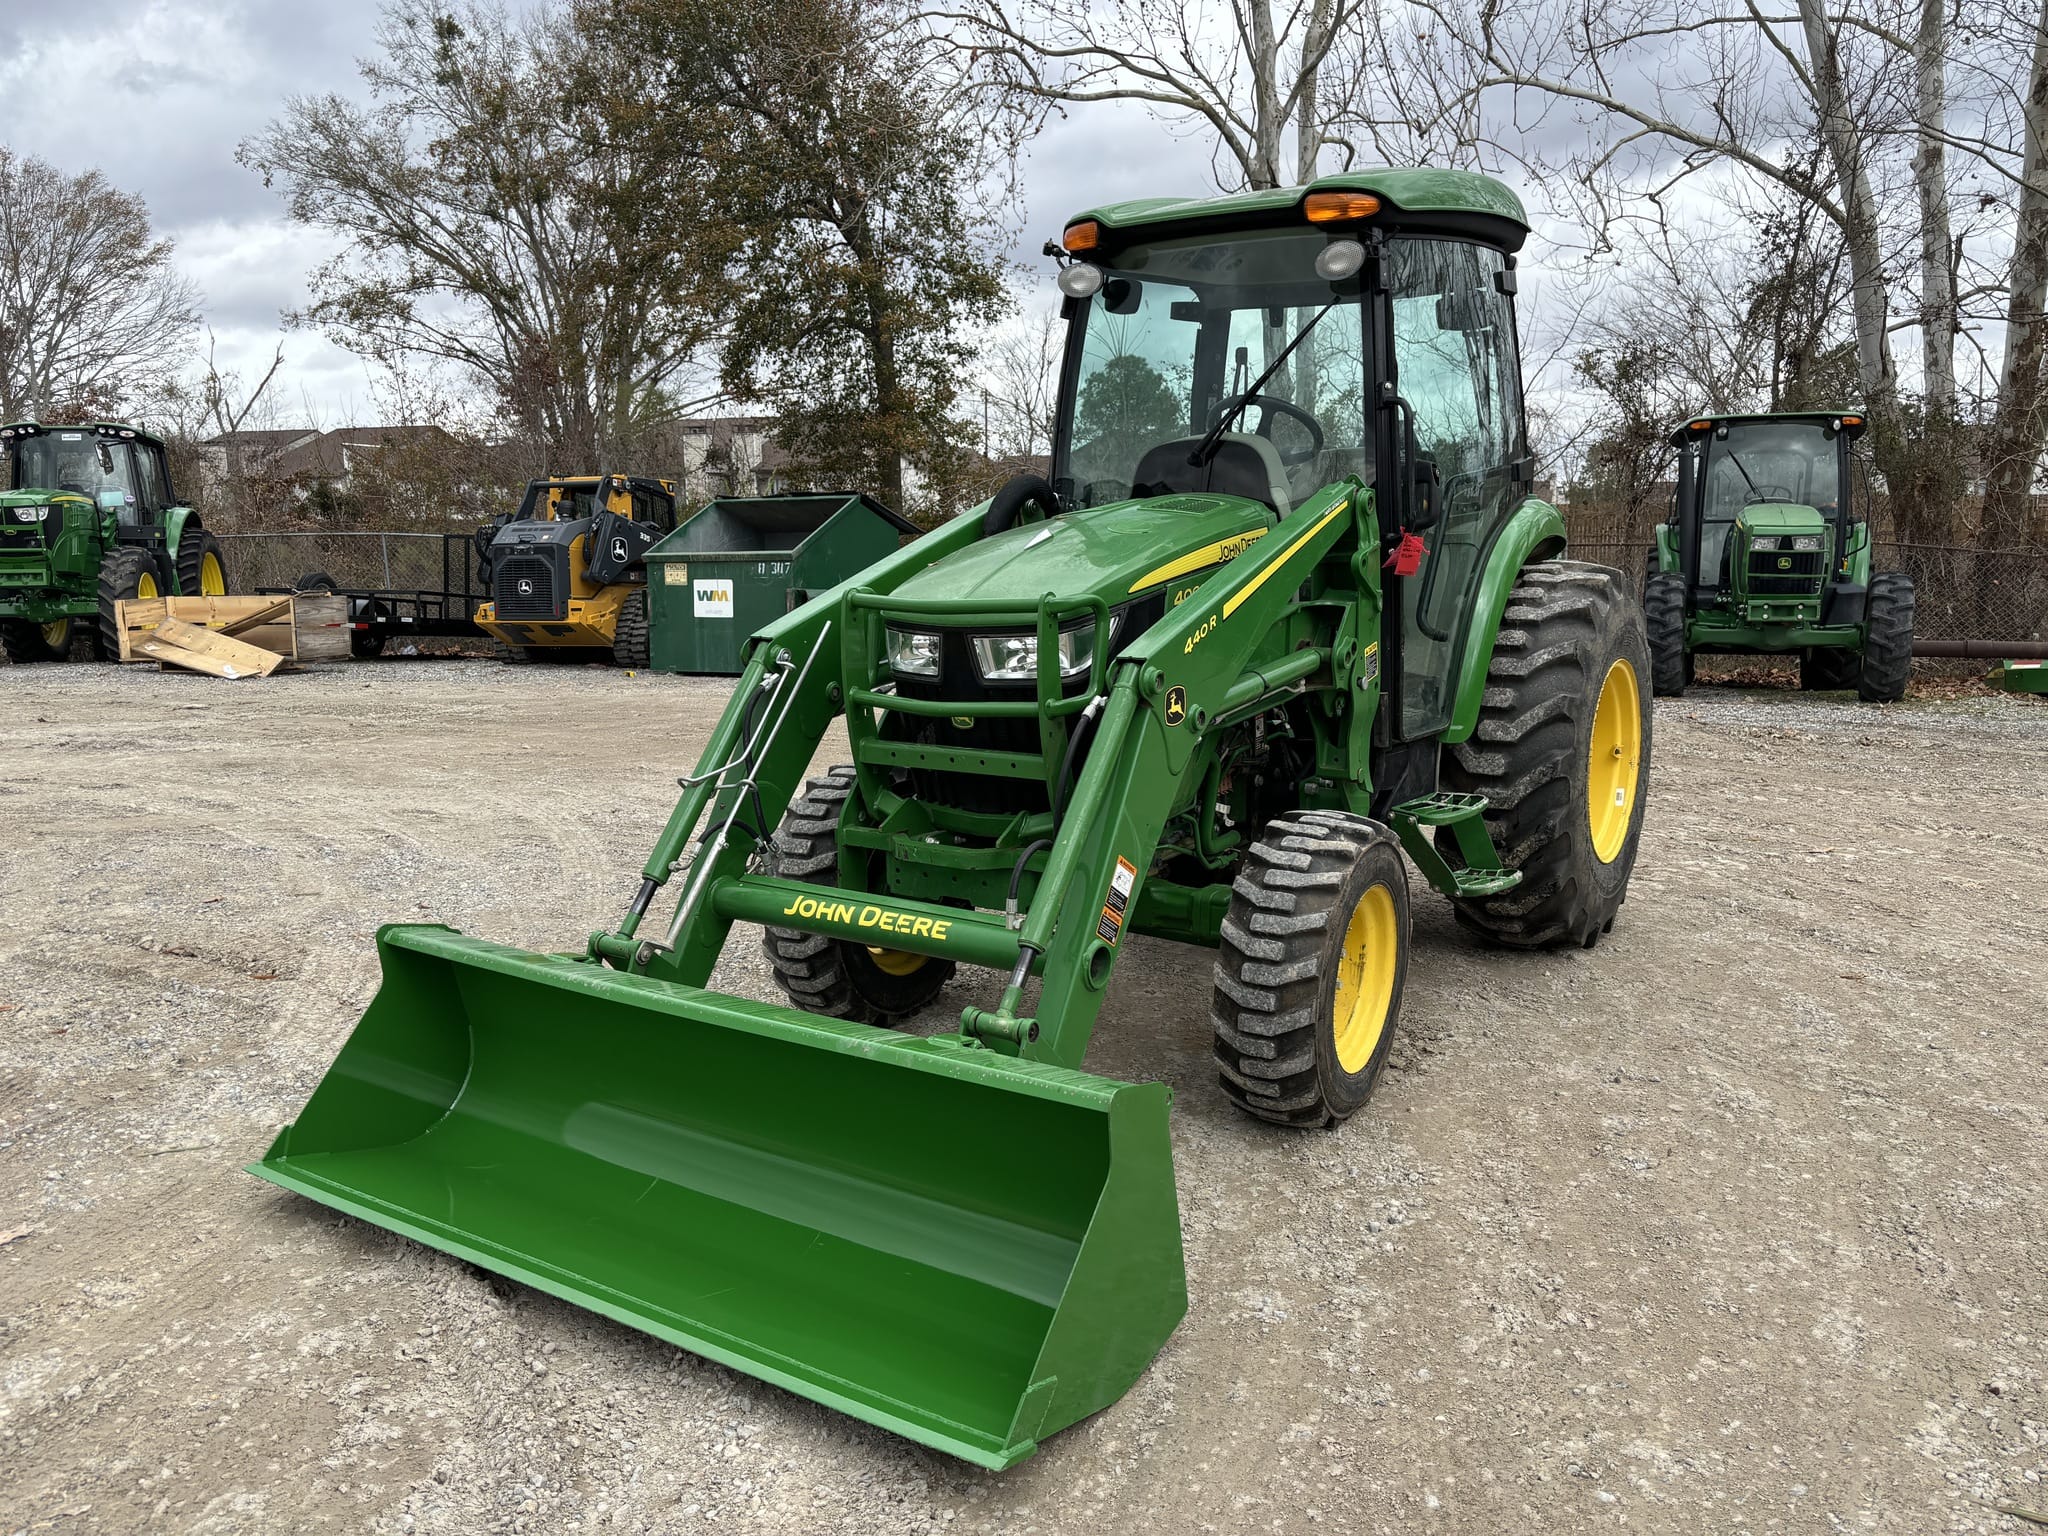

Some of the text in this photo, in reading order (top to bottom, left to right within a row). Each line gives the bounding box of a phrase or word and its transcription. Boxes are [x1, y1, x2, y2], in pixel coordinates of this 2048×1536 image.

[1219, 543, 1241, 561] JOHN
[697, 589, 729, 602] WM
[784, 896, 952, 940] JOHN DEERE
